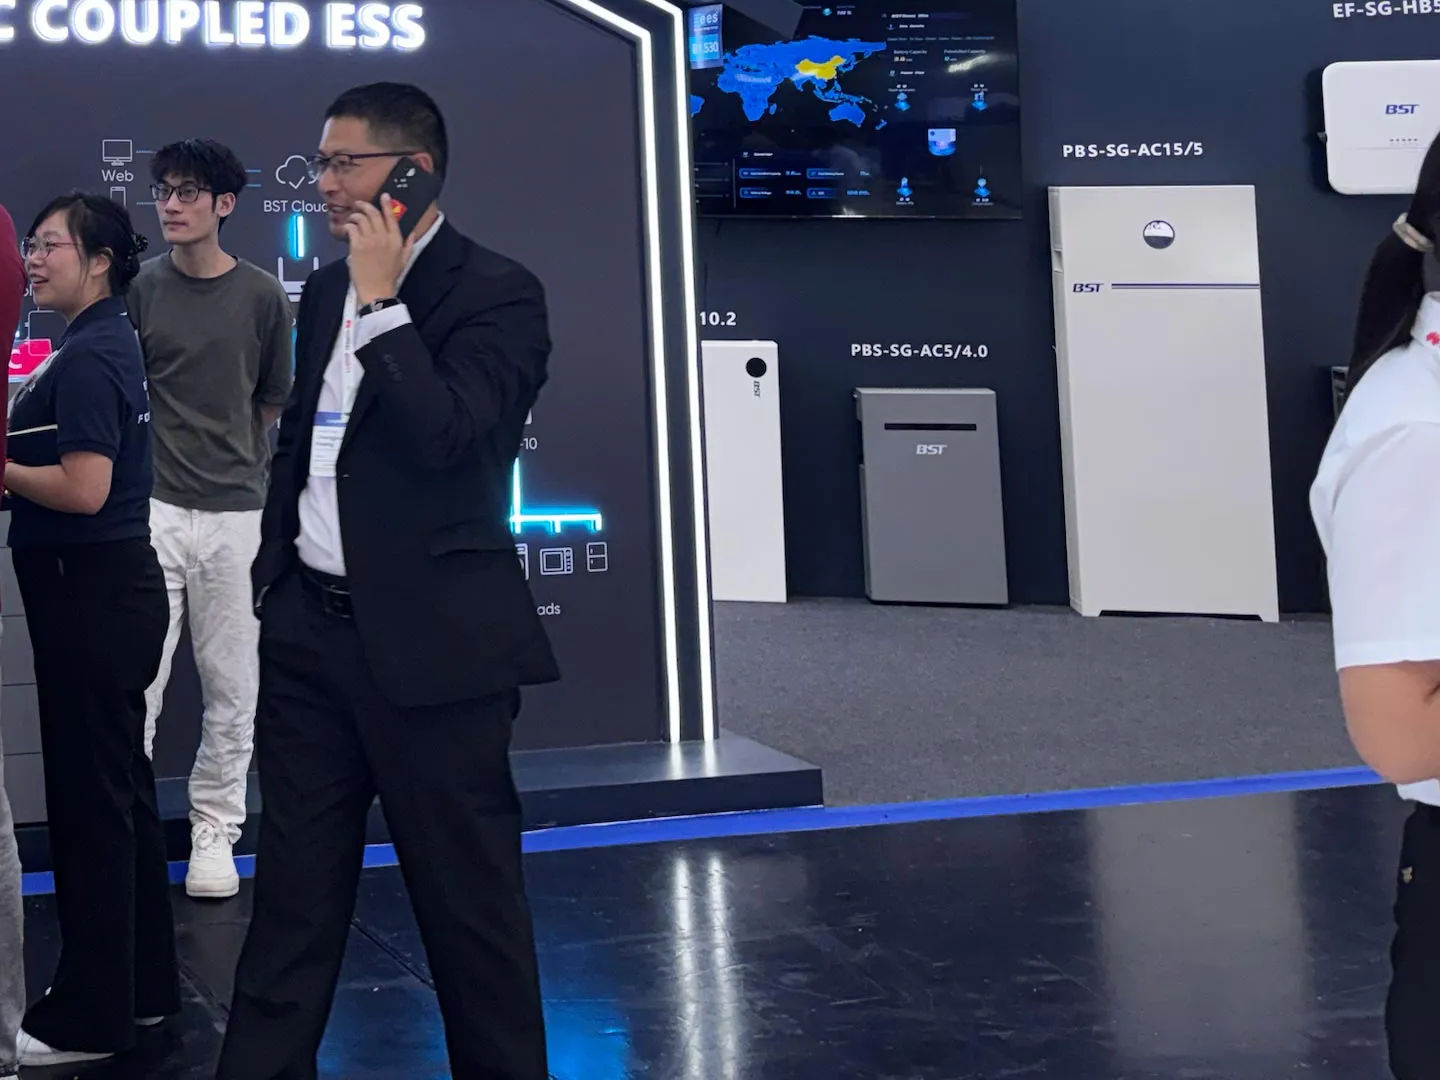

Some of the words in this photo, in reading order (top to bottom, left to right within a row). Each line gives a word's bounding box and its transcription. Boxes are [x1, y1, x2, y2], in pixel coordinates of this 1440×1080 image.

[326, 1, 427, 49] ESS
[1385, 104, 1420, 115] BST
[1062, 141, 1203, 159] PBS-SG-AC15/5
[101, 169, 134, 182] Web
[263, 200, 288, 212] BST
[1072, 282, 1104, 293] BST
[699, 311, 737, 326] 10.2
[850, 343, 988, 359] PBS-SG-AC5/4.0
[916, 443, 948, 455] BST
